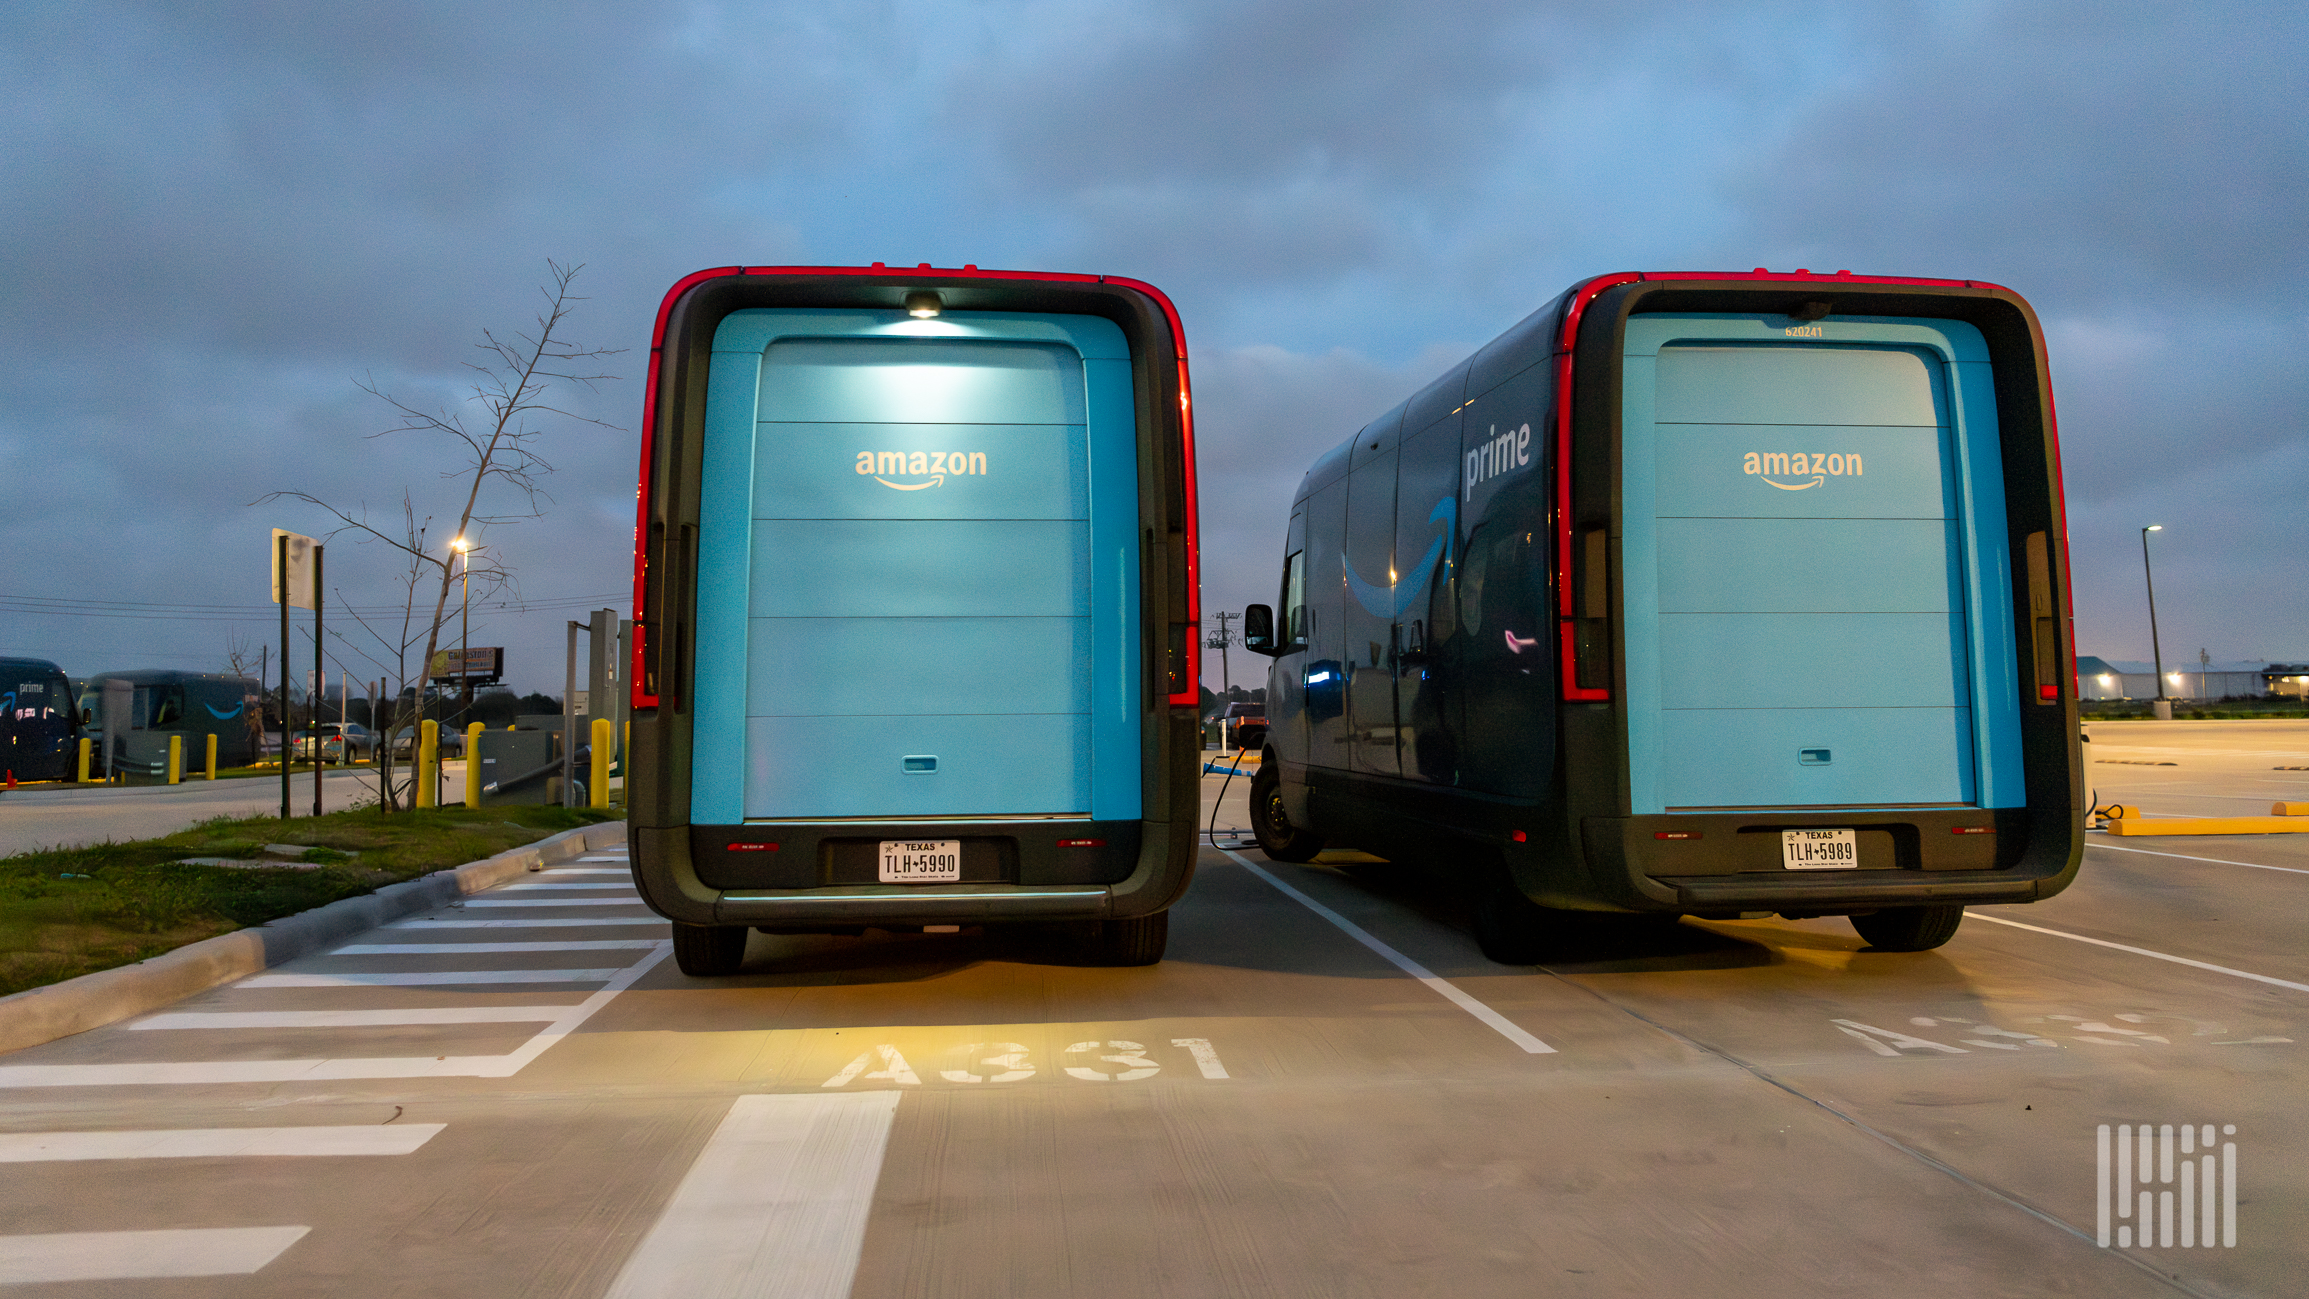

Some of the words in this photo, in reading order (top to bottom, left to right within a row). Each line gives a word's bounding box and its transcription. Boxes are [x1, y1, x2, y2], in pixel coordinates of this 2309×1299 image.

[1785, 326, 1823, 338] 620241
[854, 450, 987, 476] amazon
[1465, 422, 1531, 503] prime
[1743, 451, 1864, 477] amazon
[19, 680, 44, 696] prime
[1804, 831, 1833, 840] TEXAS
[904, 843, 936, 852] TEXAS
[821, 1037, 1230, 1088] A331
